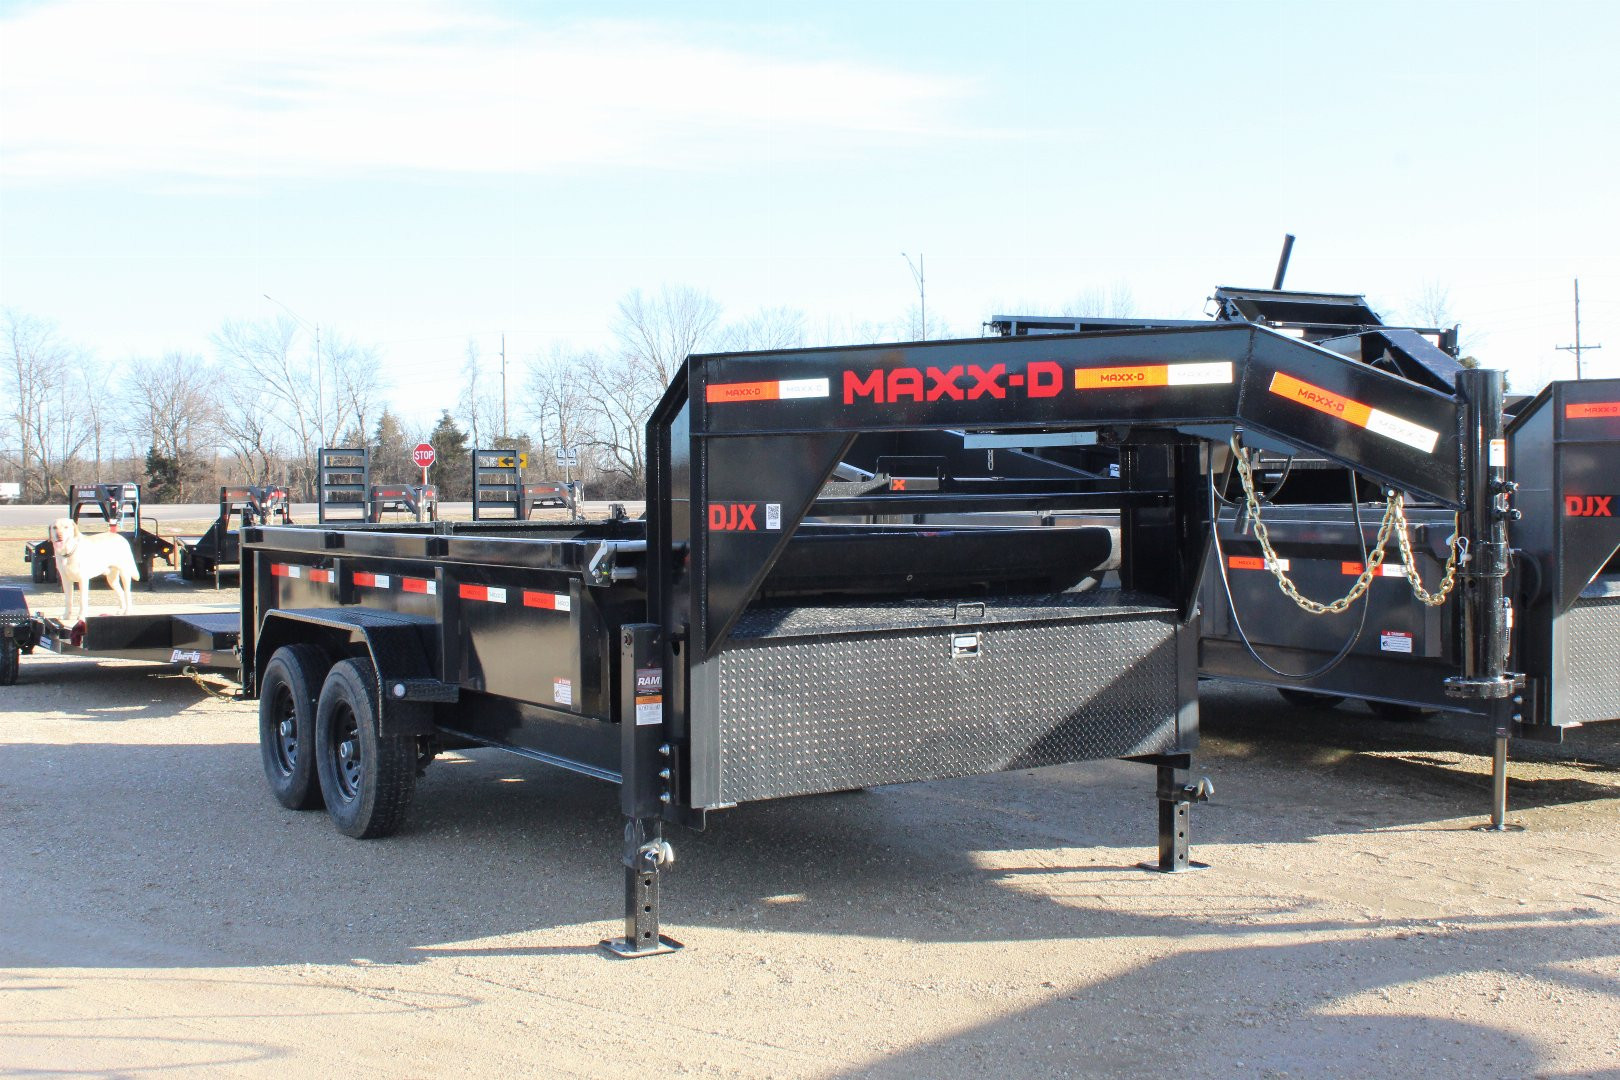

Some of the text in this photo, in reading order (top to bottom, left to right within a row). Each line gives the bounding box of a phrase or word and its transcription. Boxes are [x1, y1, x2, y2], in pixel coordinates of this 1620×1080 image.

[844, 361, 1063, 405] MAXX-D
[1101, 373, 1145, 382] MAXX-D
[726, 388, 761, 396] MAXX-D
[1298, 388, 1345, 412] MAXX-D
[414, 451, 434, 460] STOP
[1565, 496, 1612, 517] DJX
[708, 504, 757, 531] DJX
[638, 676, 660, 686] RAM
